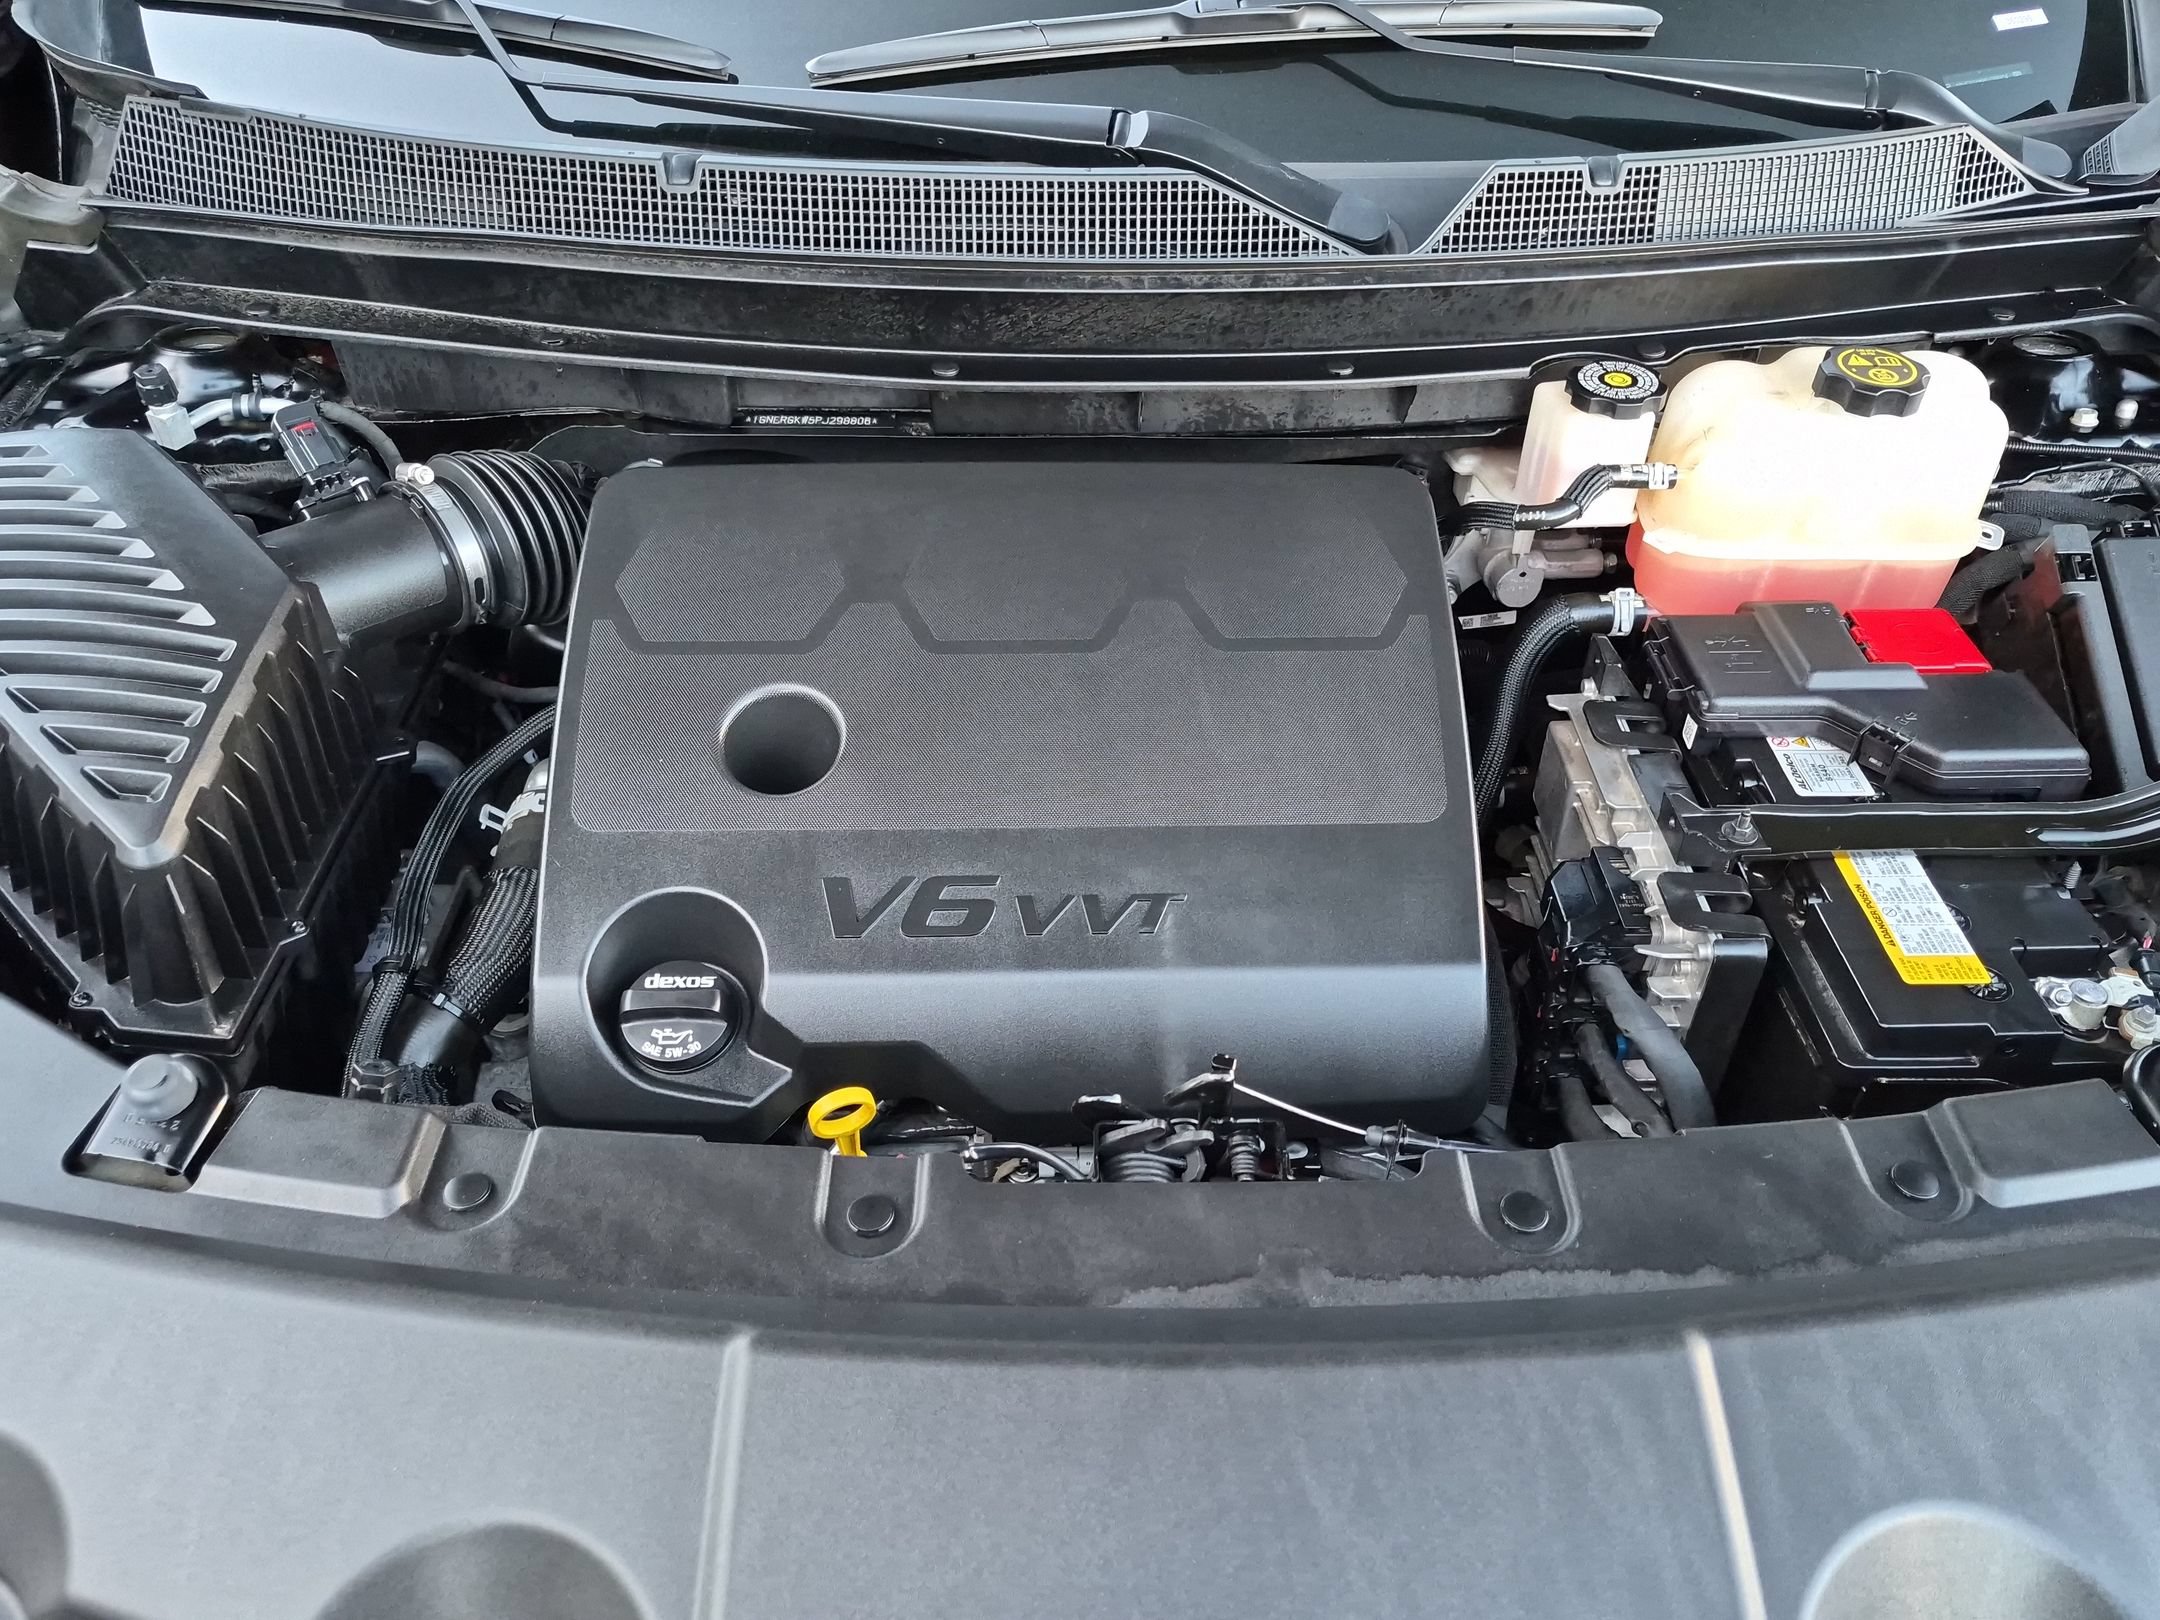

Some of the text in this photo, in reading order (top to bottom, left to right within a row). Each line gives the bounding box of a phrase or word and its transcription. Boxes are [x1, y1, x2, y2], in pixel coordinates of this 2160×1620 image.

[1783, 753, 1809, 791] ACDelco
[821, 875, 1188, 939] V6 VVT
[1853, 883, 1892, 940] DANGER POISON
[644, 973, 718, 989] dexos
[641, 1041, 702, 1059] SAE 5W-30
